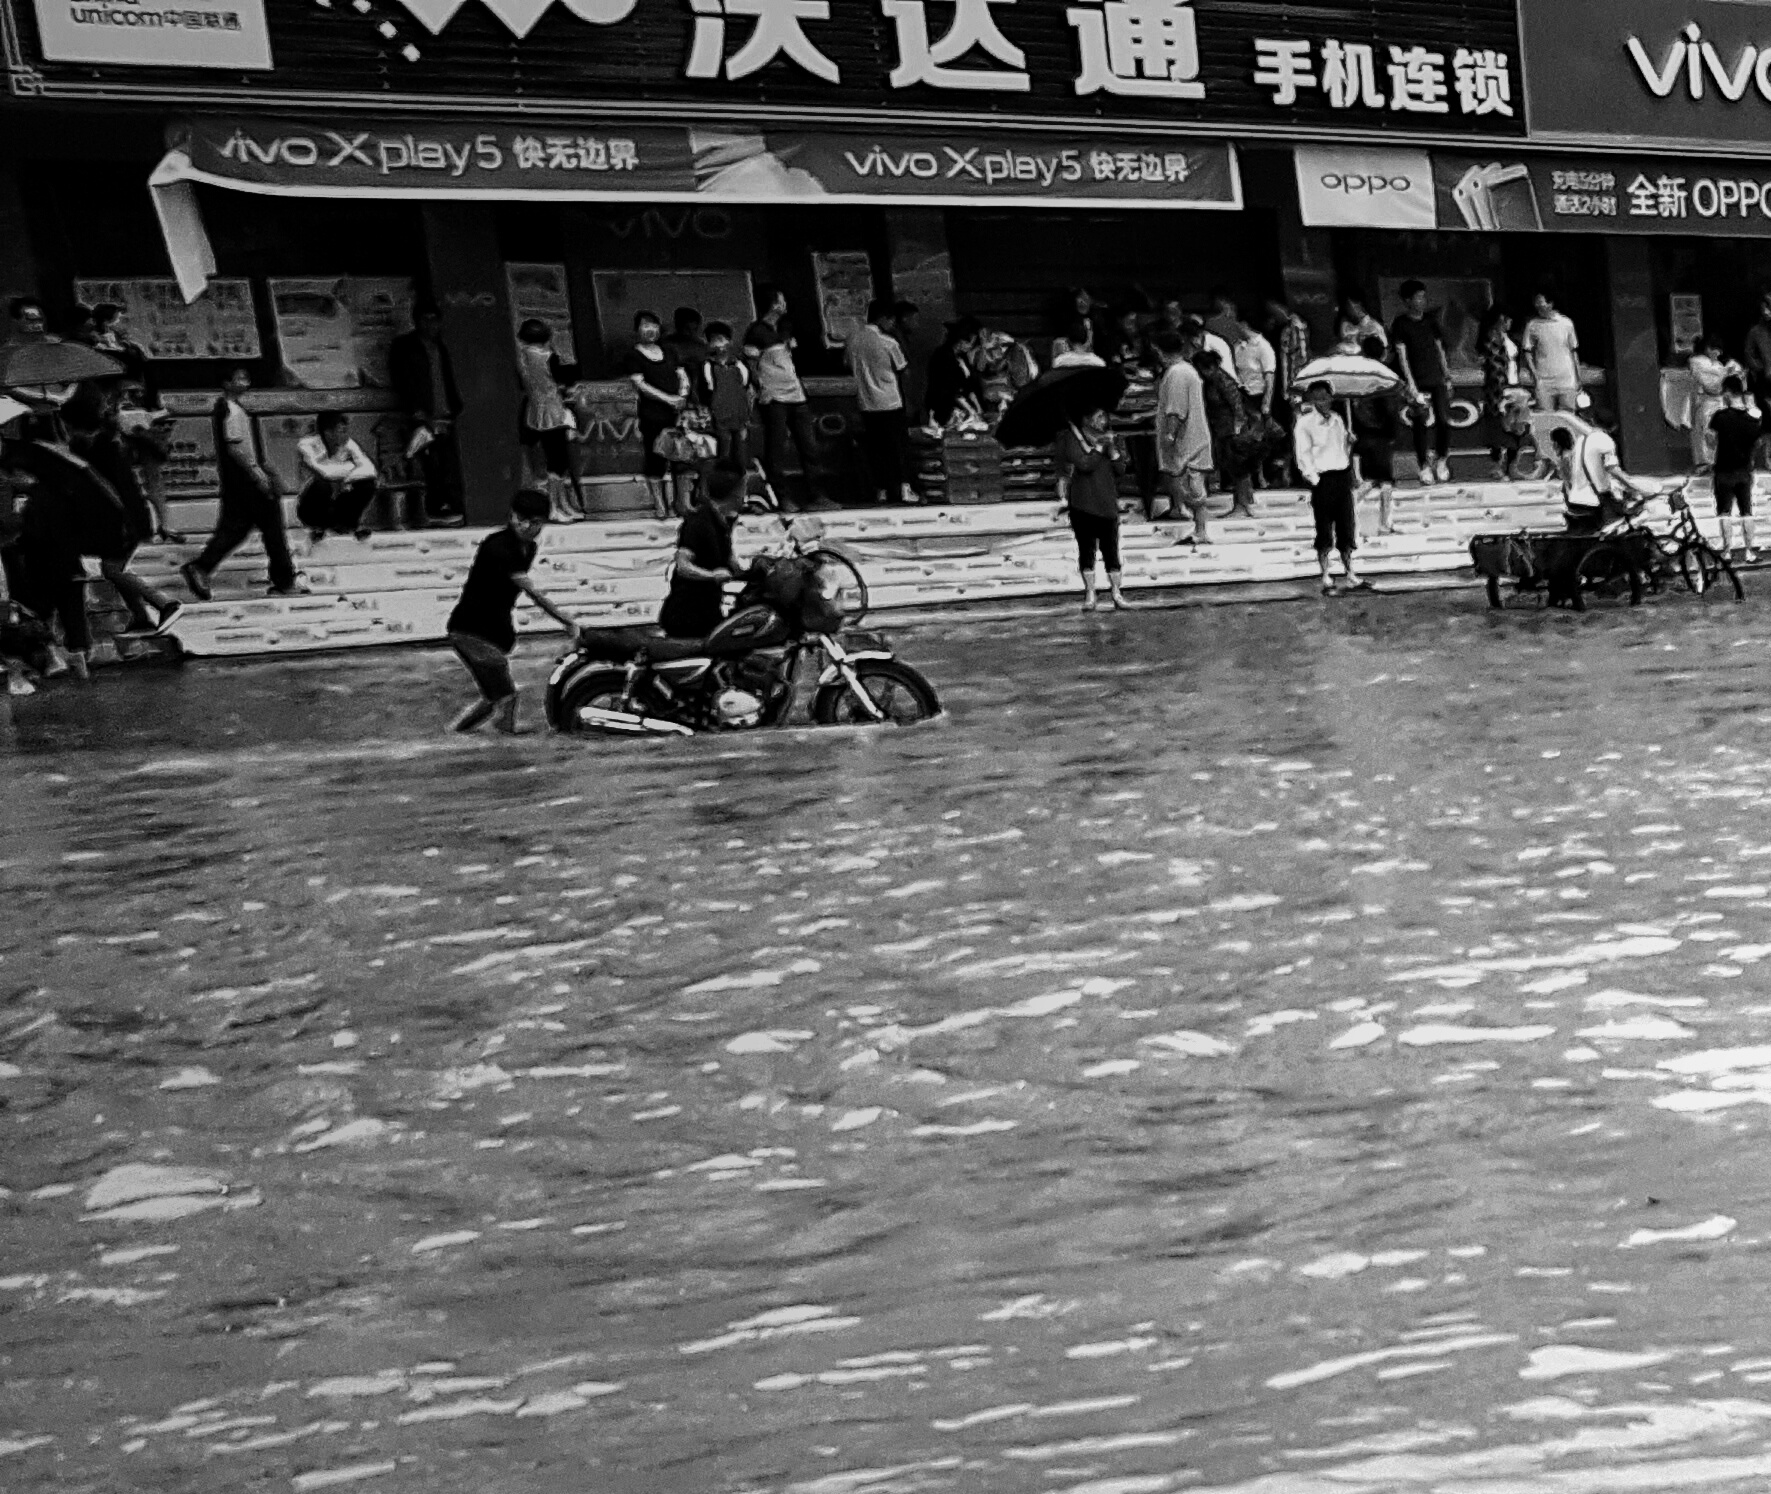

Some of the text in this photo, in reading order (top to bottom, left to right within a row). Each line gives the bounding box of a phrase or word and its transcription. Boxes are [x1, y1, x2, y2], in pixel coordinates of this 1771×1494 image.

[1253, 38, 1513, 117] 手机连锁
[513, 134, 640, 171] 快无边界
[845, 145, 938, 177] vivo
[1090, 151, 1190, 182] 快无边界
[1320, 173, 1411, 194] oppo
